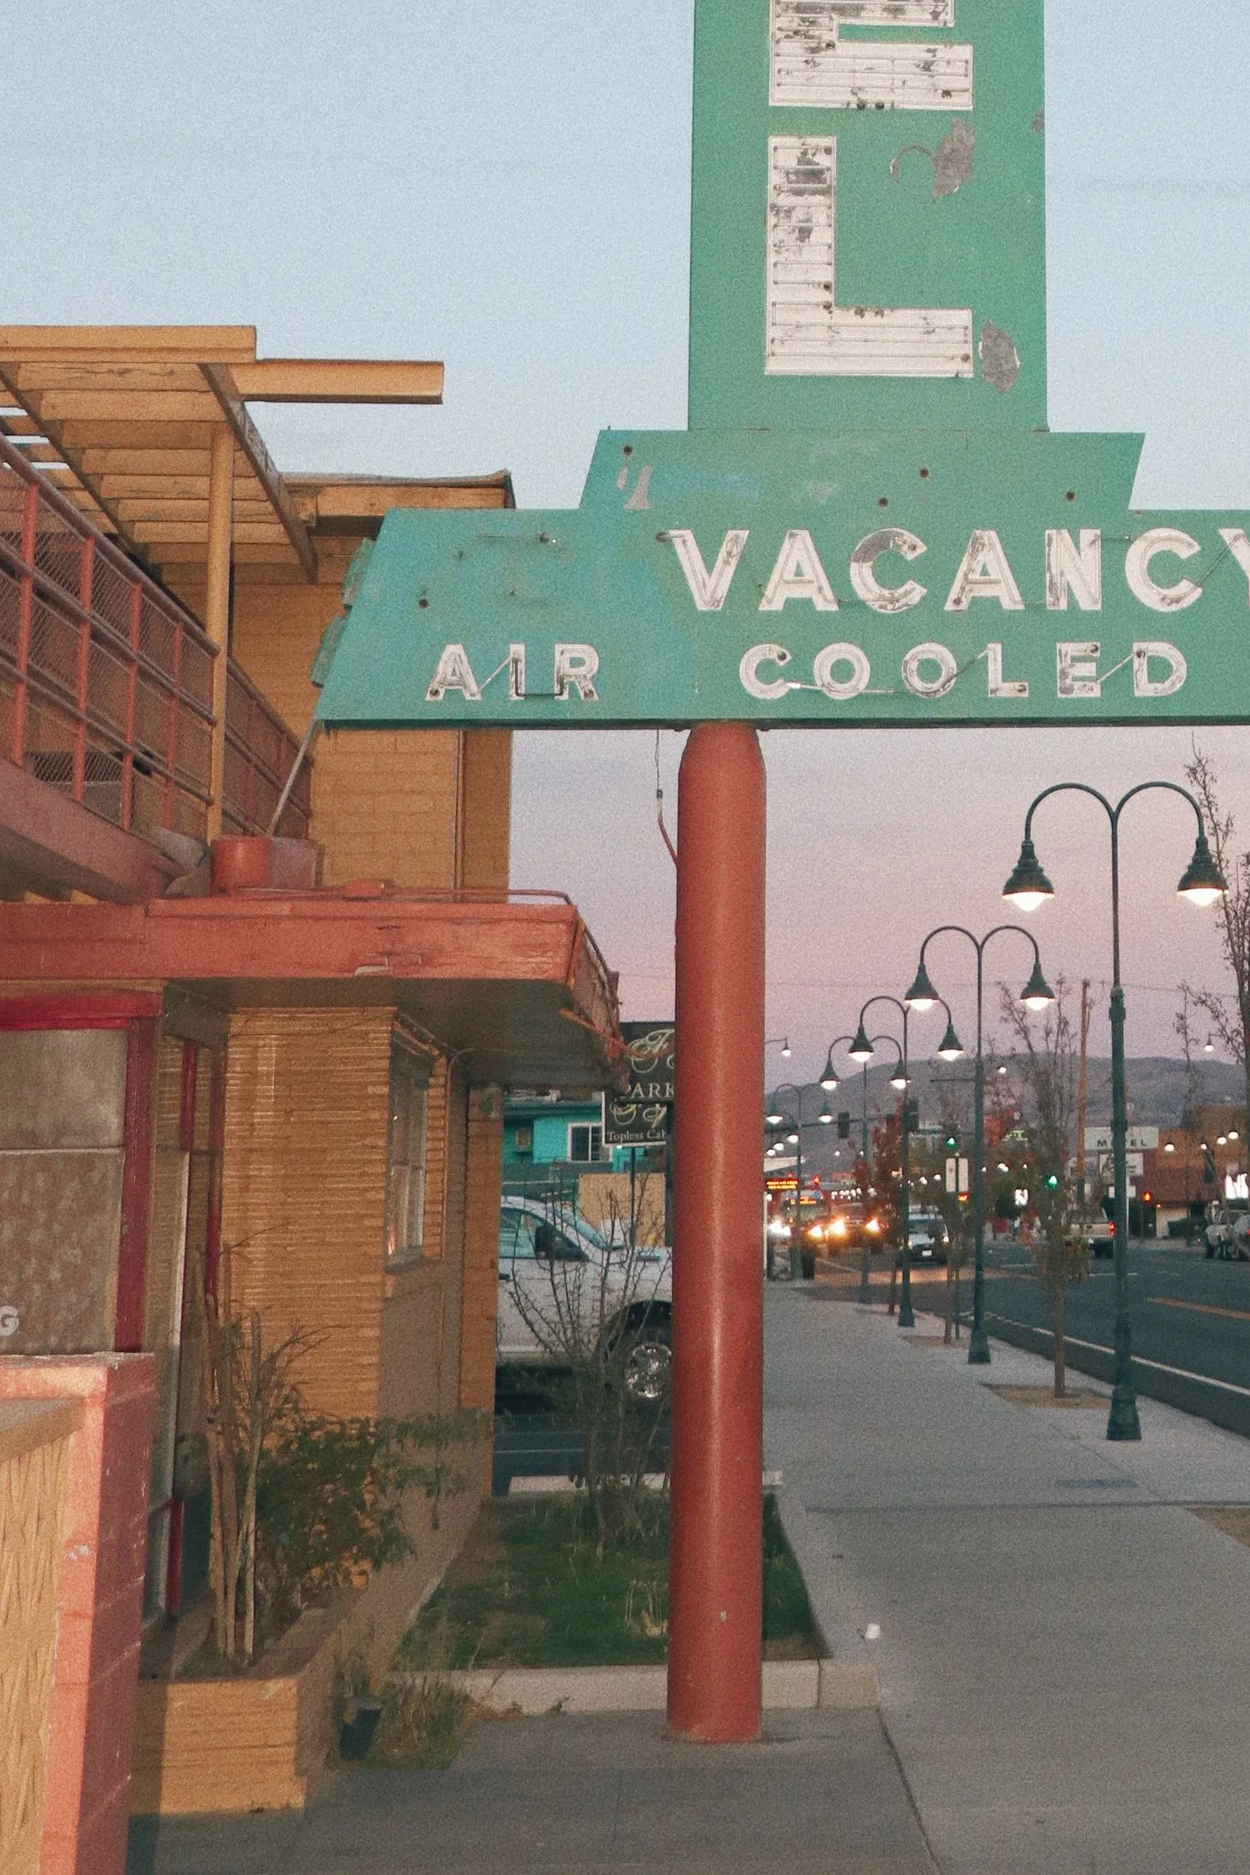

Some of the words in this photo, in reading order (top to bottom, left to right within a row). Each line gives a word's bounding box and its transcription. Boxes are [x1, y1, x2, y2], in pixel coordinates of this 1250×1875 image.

[424, 643, 601, 702] AIR
[737, 640, 1189, 702] COOLED
[1097, 1138, 1147, 1147] MEL
